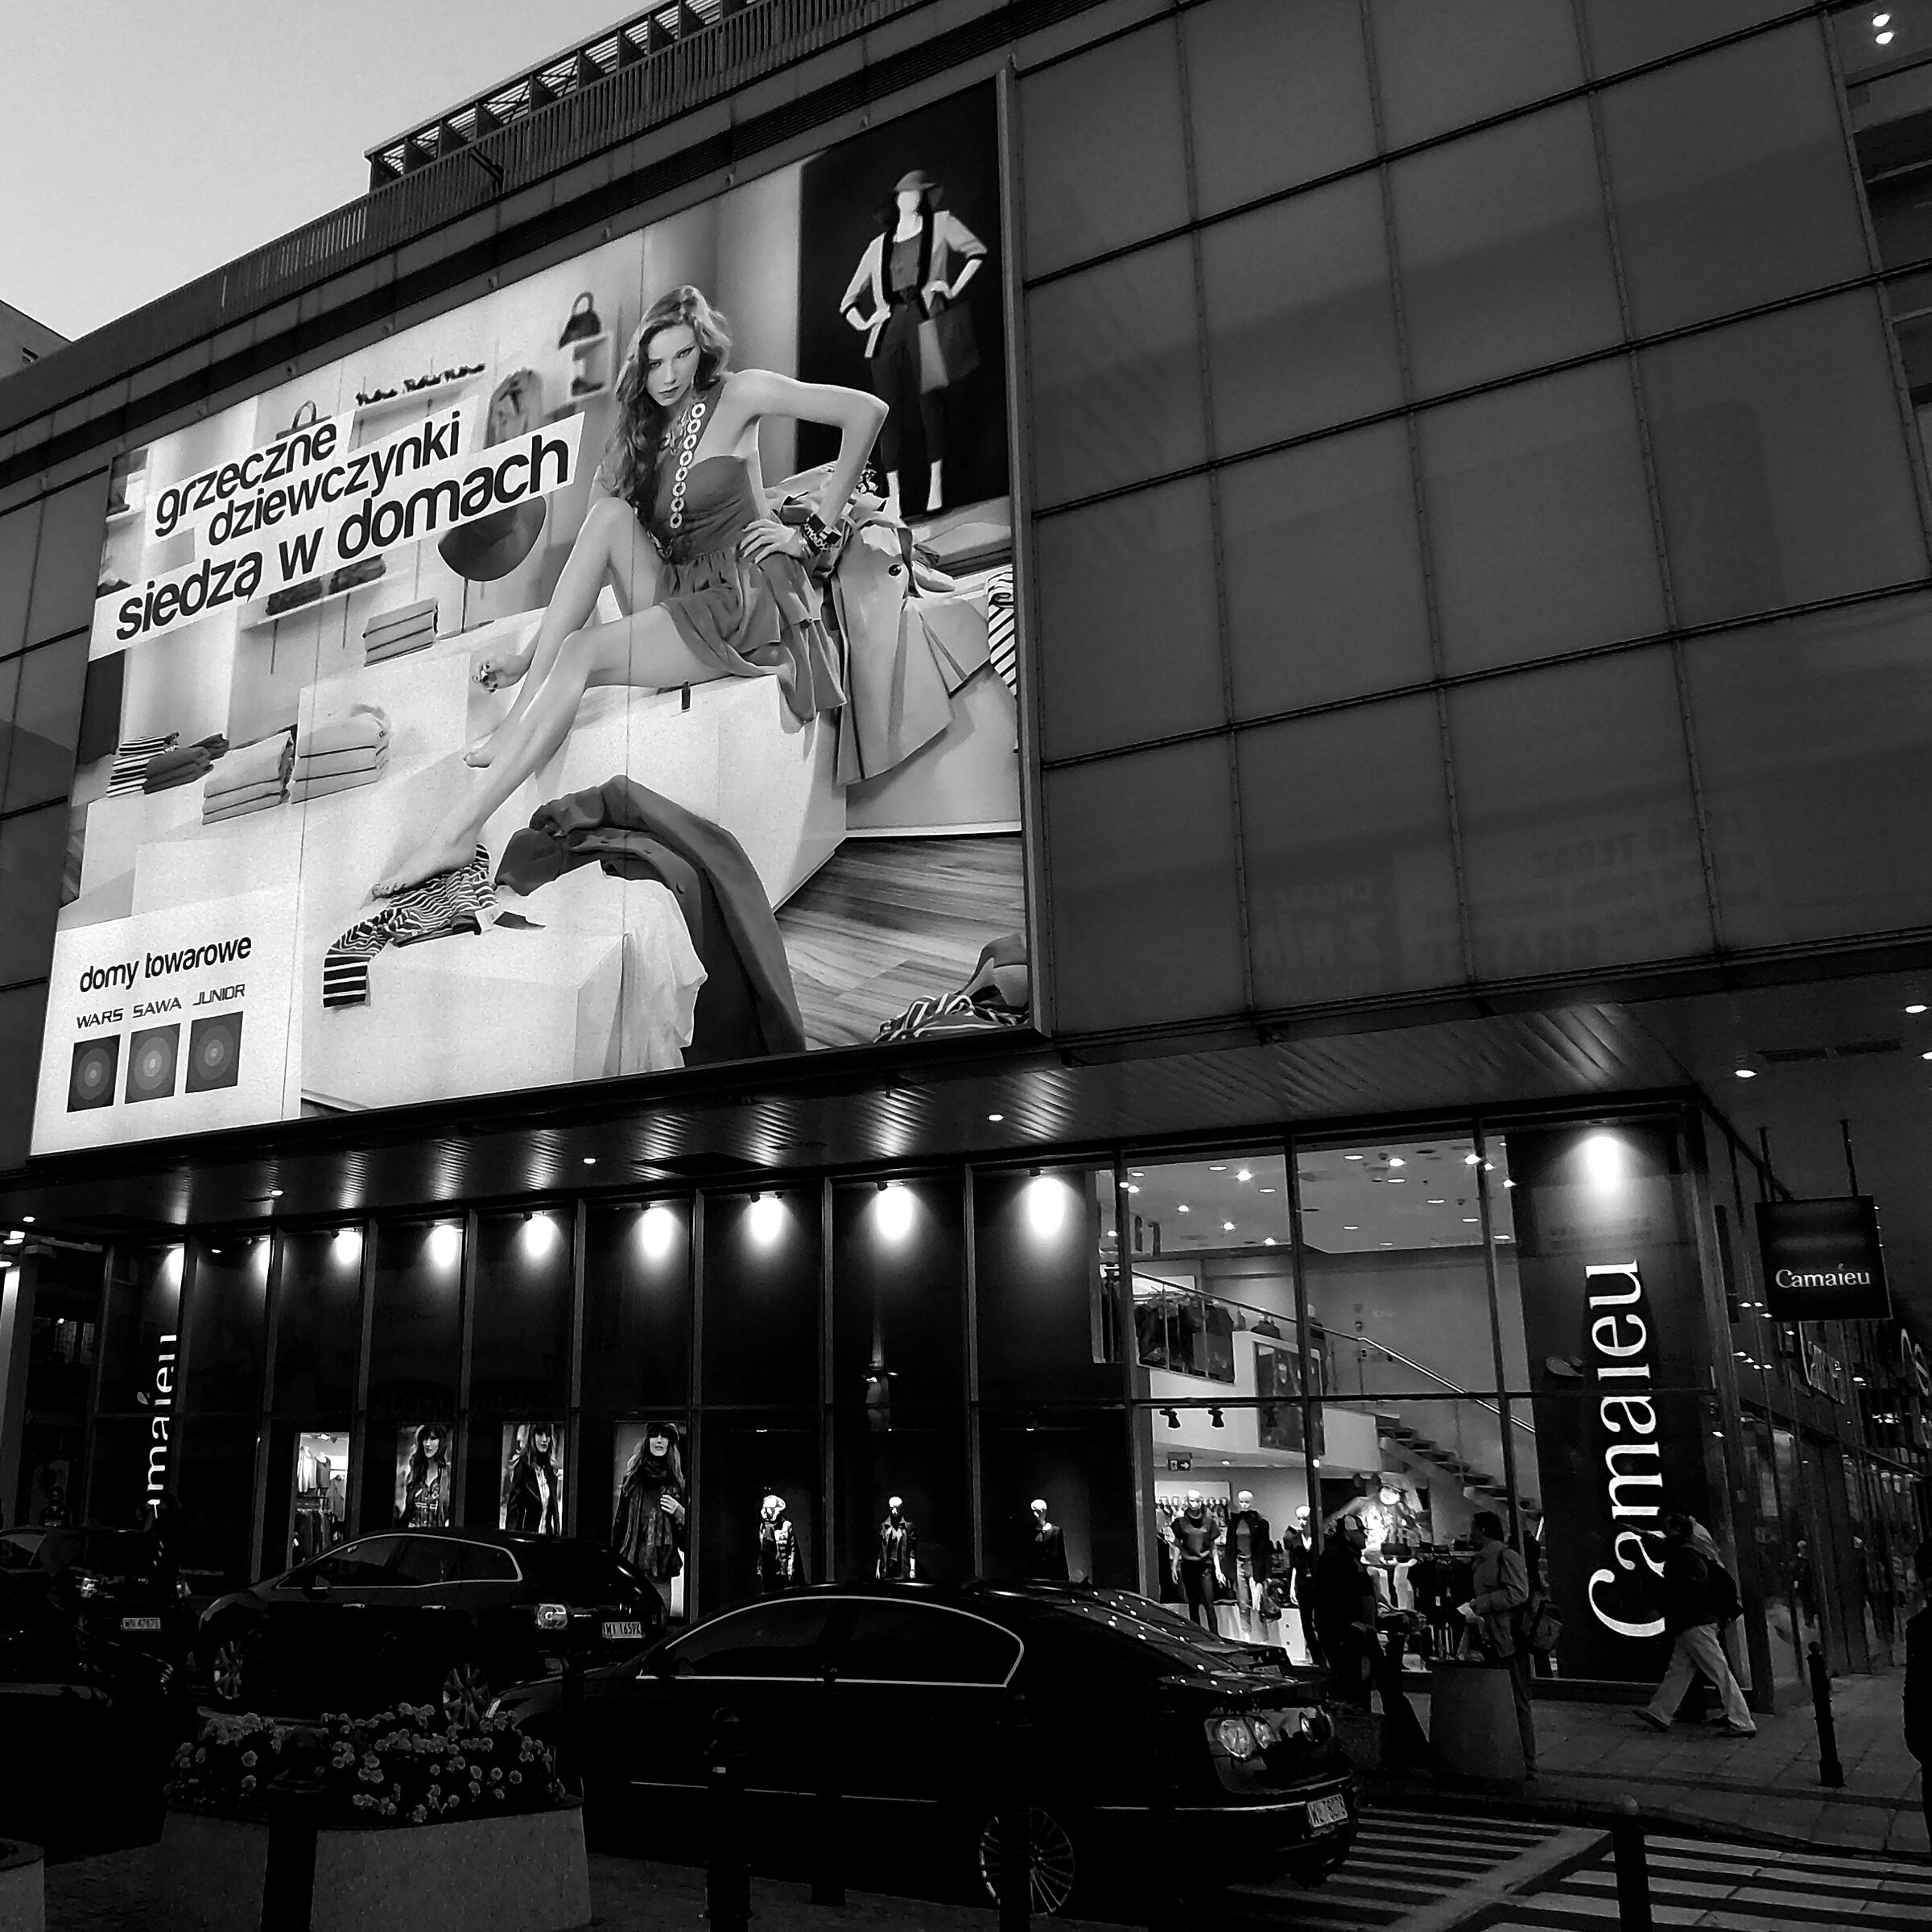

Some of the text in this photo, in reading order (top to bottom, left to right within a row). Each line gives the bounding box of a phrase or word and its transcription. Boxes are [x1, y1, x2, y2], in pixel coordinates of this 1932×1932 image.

[153, 421, 337, 538] grzeczne
[208, 411, 461, 547] dziewczynki
[278, 525, 323, 582] w
[337, 435, 569, 559] domach
[76, 984, 246, 1029] WARS SAWA JUNIOR
[80, 936, 252, 993] domy towarowe
